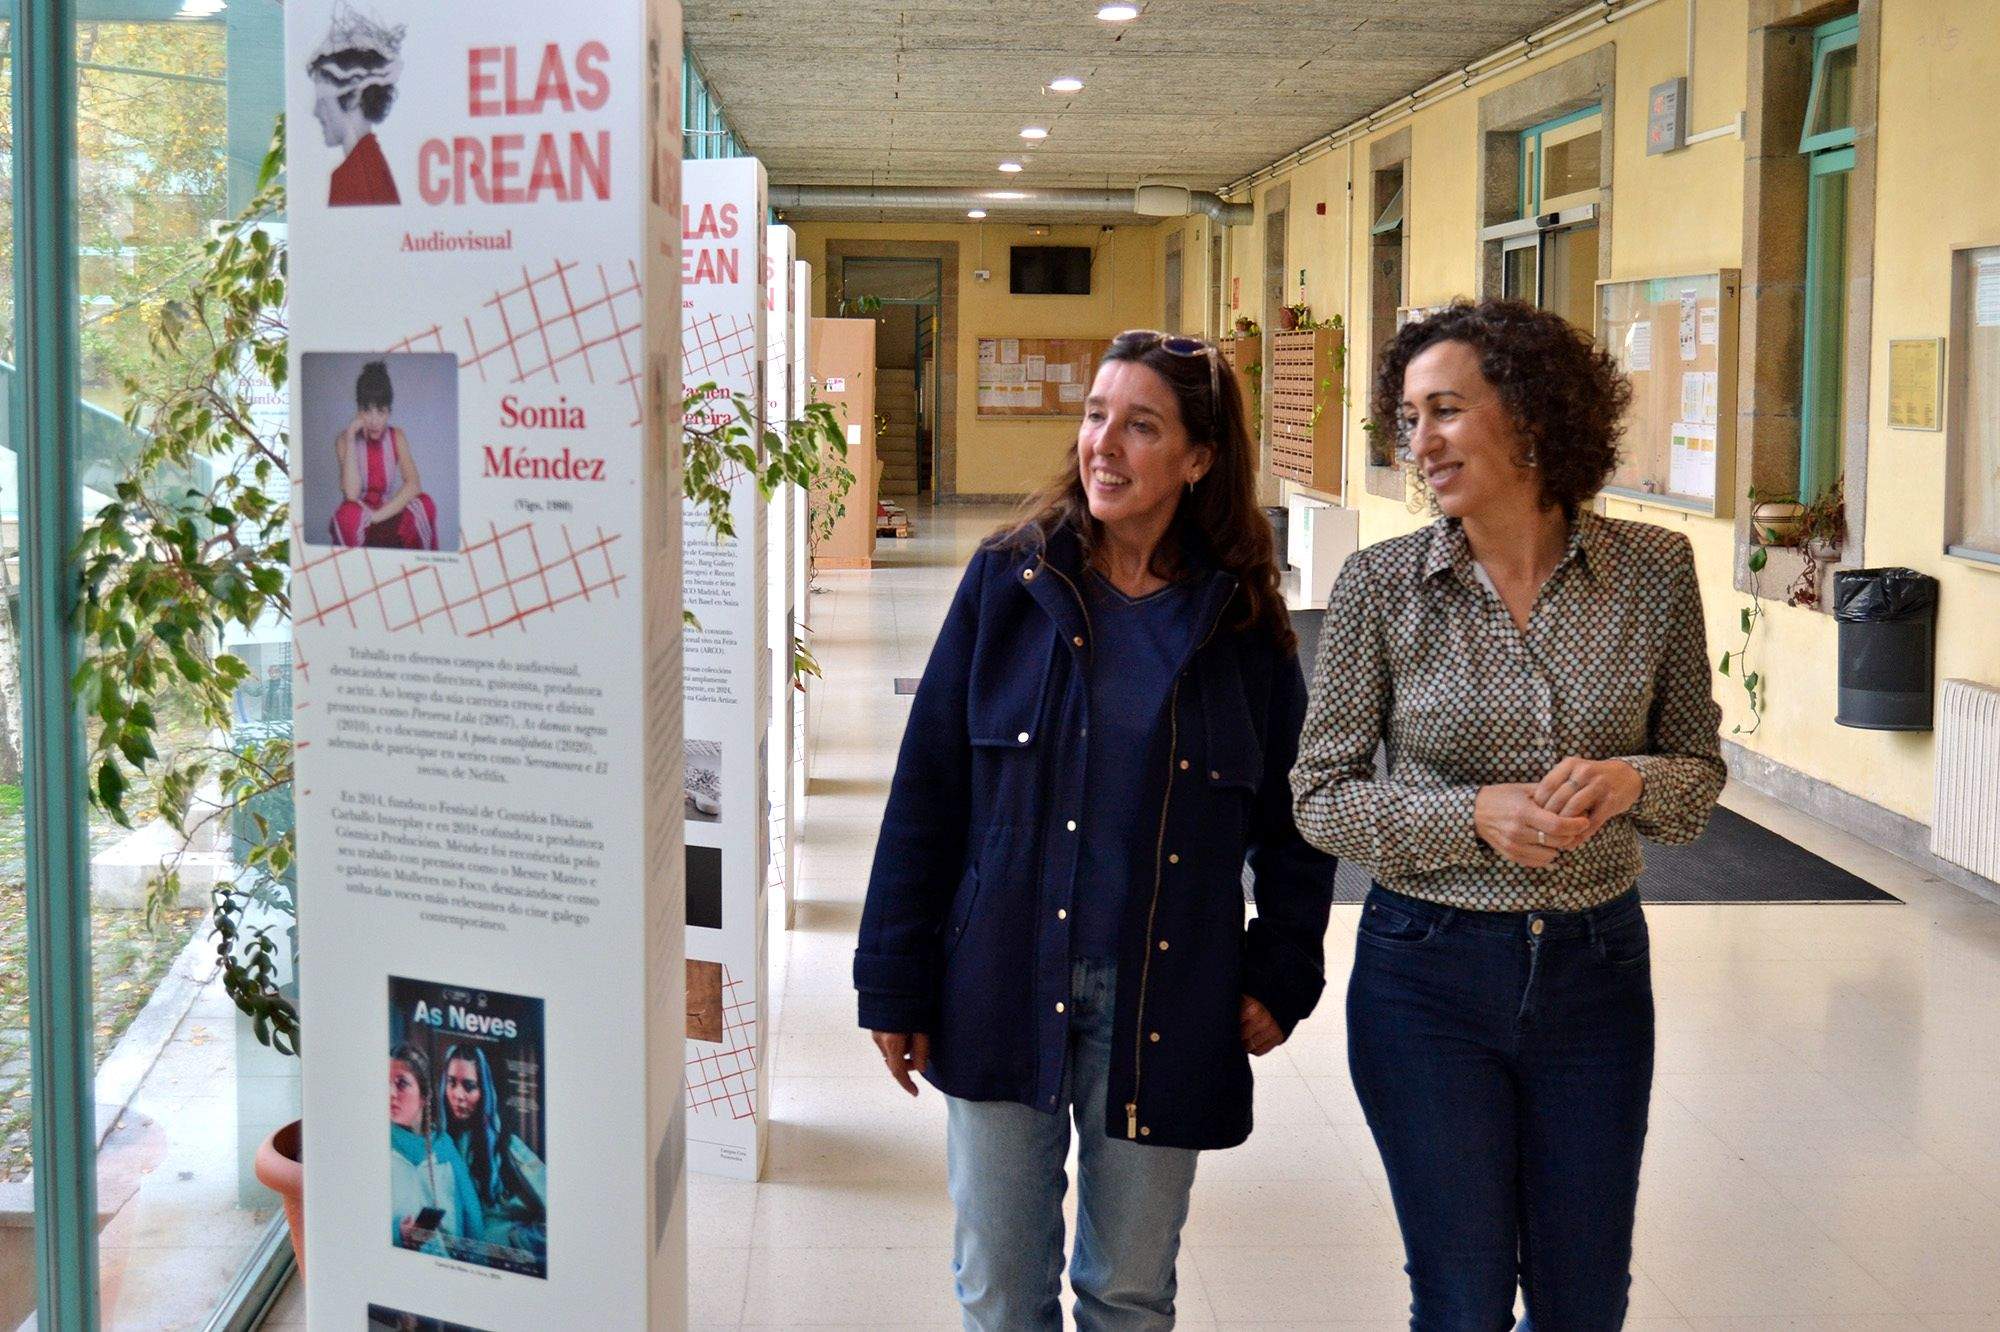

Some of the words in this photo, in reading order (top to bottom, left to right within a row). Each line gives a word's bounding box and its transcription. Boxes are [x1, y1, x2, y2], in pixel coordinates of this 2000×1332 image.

[468, 41, 610, 117] ELAS
[418, 131, 610, 206] CREAN
[682, 203, 739, 239] LAS
[401, 230, 512, 253] Audiovisual
[681, 248, 739, 284] EAN
[500, 395, 586, 430] Sonia
[684, 412, 732, 425] ereira
[482, 446, 607, 482] Méndez
[414, 1000, 443, 1027] As
[448, 1004, 518, 1039] Neves
